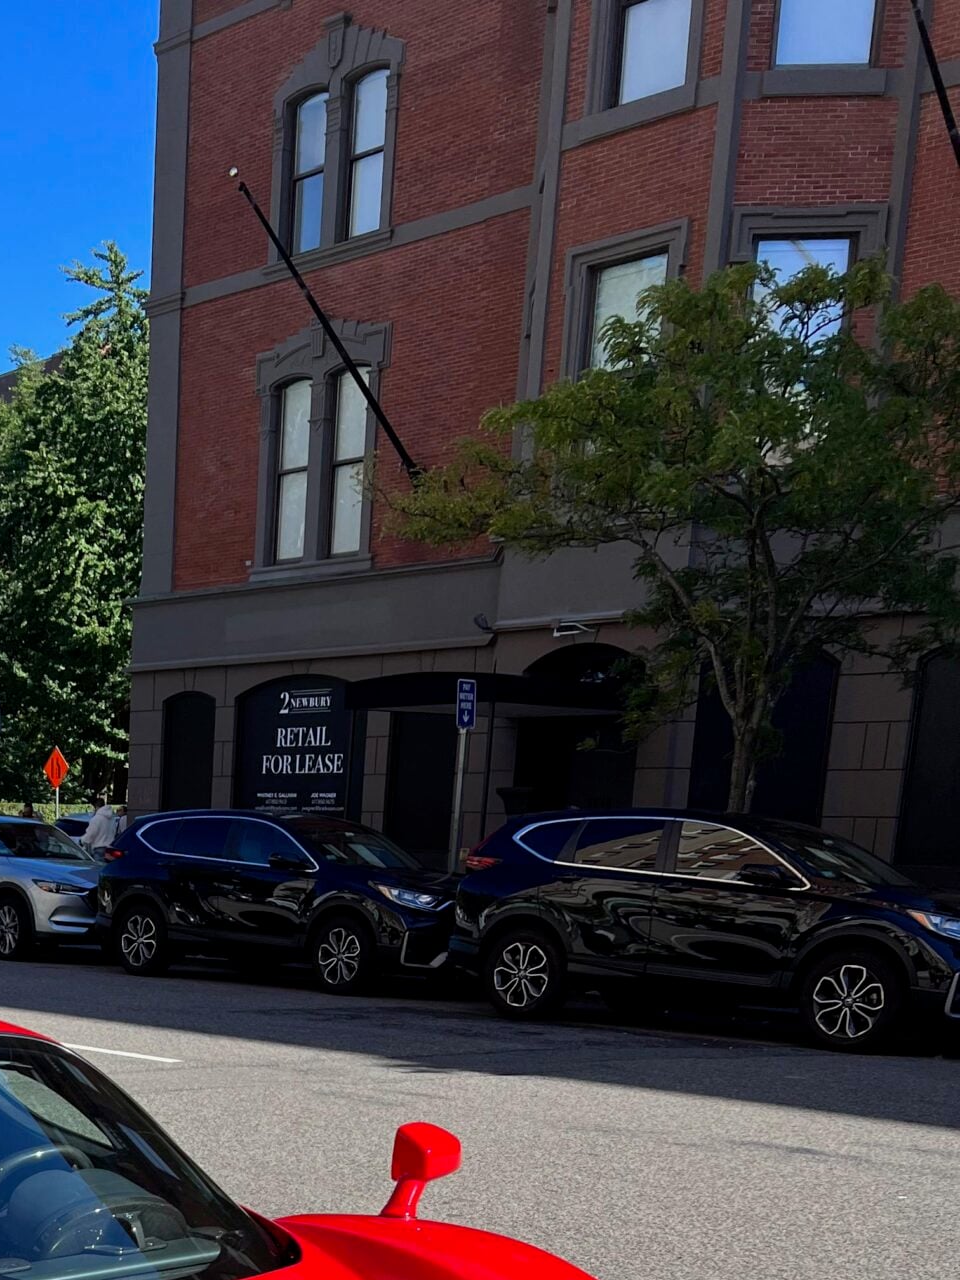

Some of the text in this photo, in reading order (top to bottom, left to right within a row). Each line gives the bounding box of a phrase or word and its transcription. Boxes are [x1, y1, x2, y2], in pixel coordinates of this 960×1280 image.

[279, 692, 332, 714] 2 NEWBURY
[276, 726, 331, 747] RETAIL
[262, 754, 343, 774] FOR LEASE
